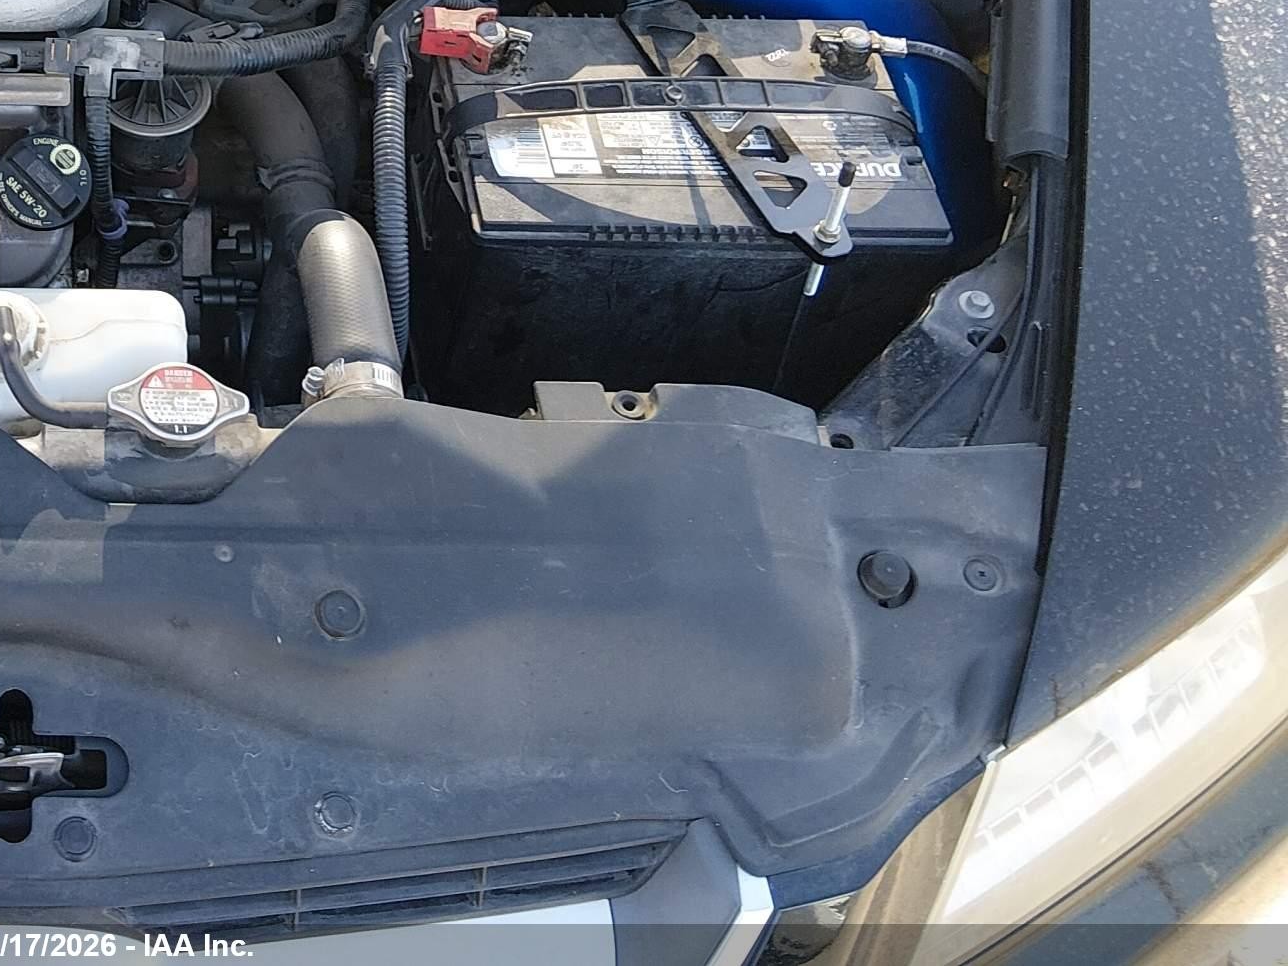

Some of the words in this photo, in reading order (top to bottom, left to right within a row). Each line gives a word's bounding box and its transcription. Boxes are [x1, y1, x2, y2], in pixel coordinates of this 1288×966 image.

[32, 136, 60, 148] ENGINE
[79, 169, 88, 187] OIL
[5, 176, 23, 195] SAE
[19, 190, 47, 218] 5W-20
